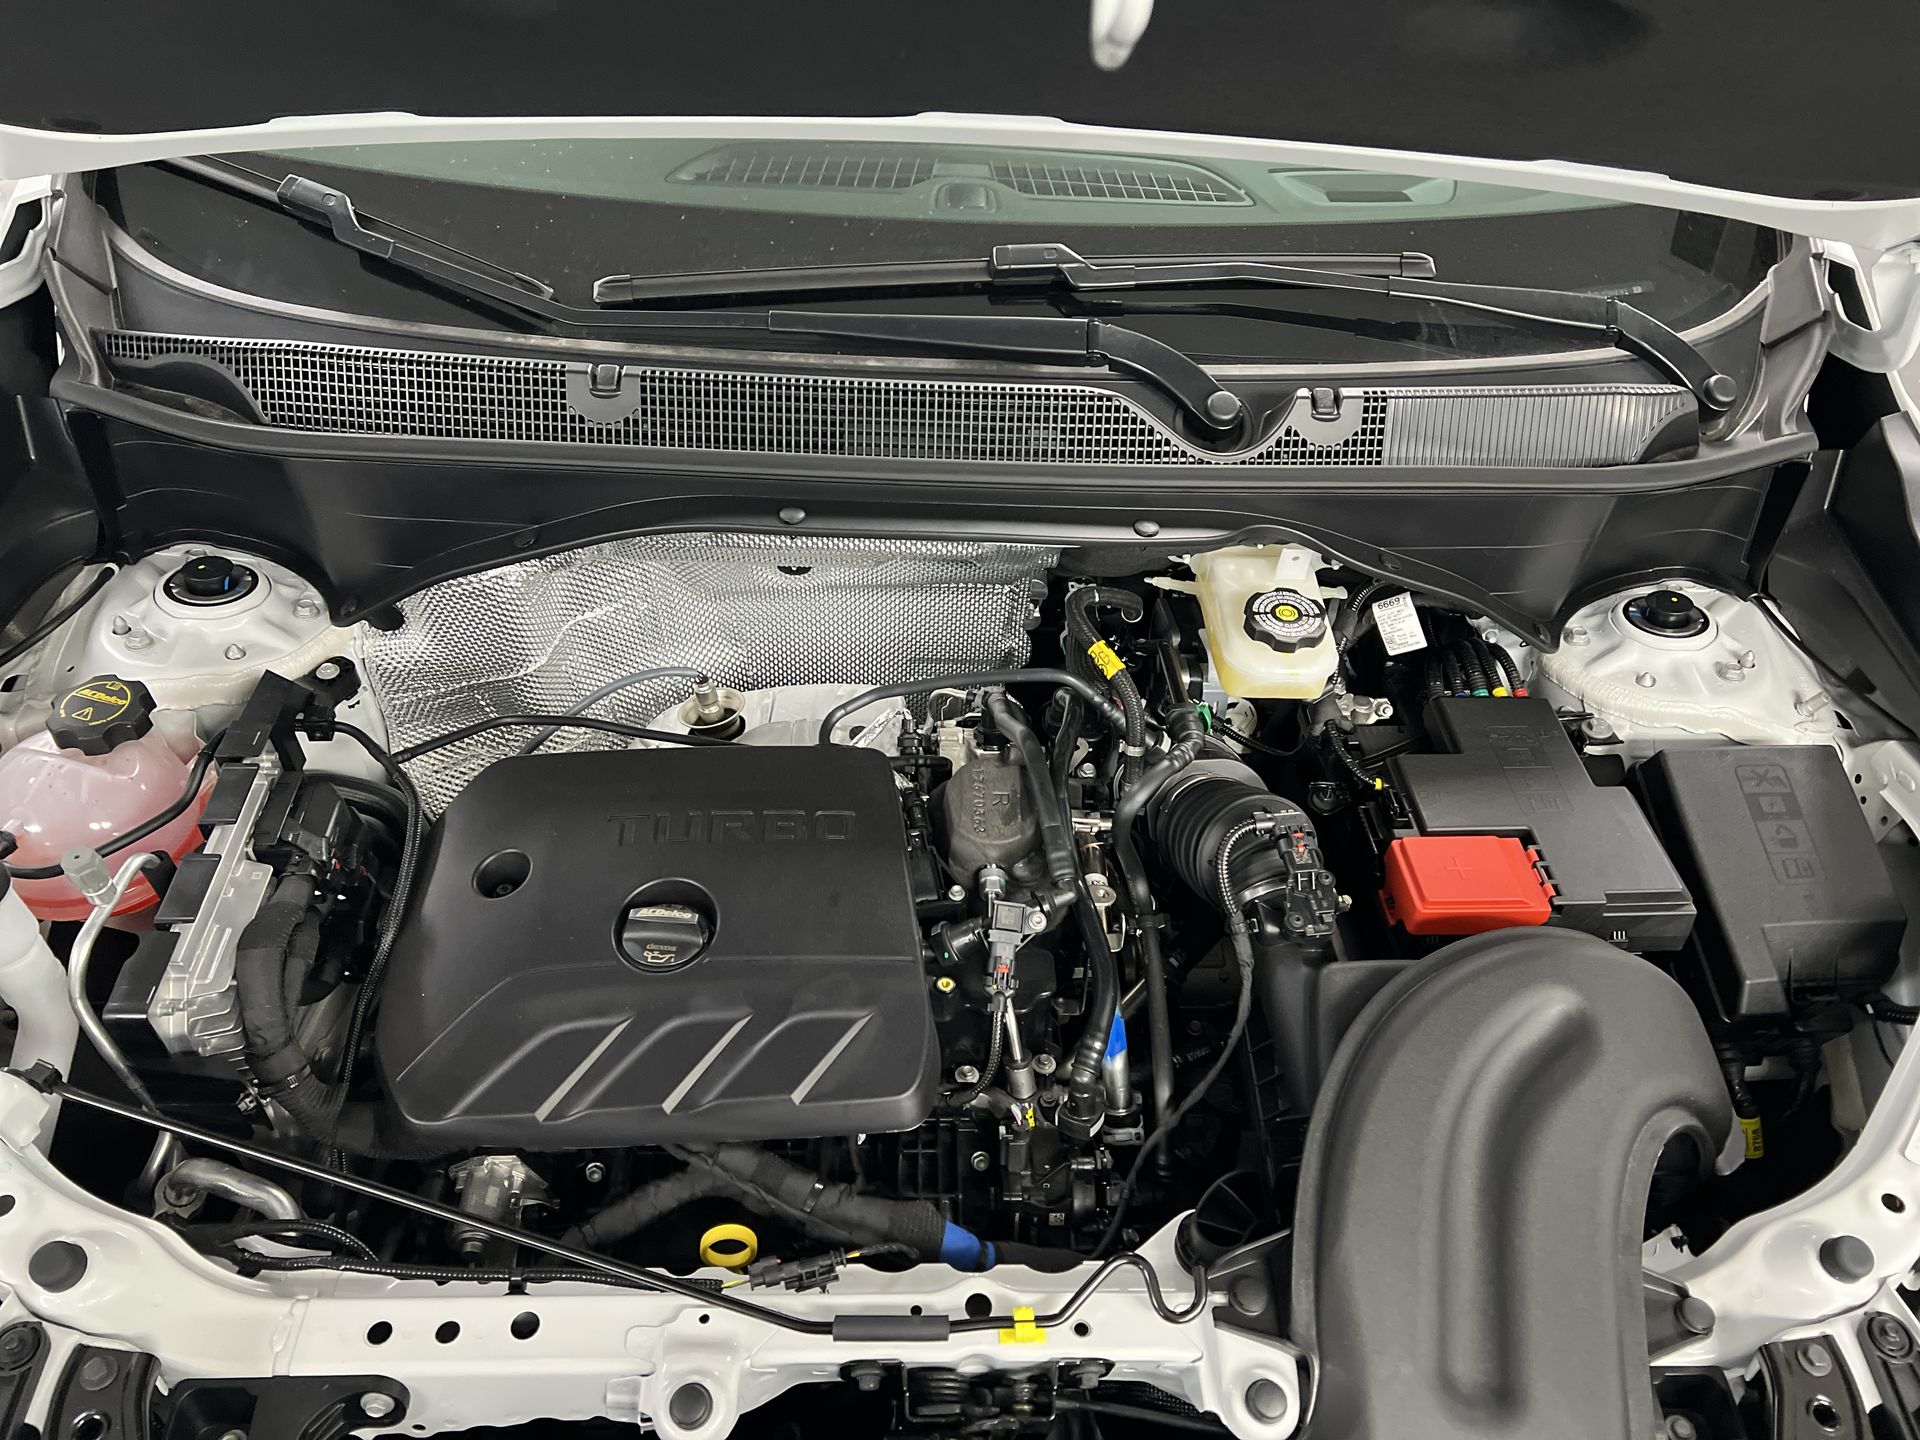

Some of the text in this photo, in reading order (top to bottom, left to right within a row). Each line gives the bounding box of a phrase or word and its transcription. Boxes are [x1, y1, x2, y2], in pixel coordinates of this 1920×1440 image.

[1377, 597, 1401, 610] 6669
[991, 791, 1010, 806] R
[607, 810, 857, 846] TURBO
[637, 907, 692, 919] ACDelco
